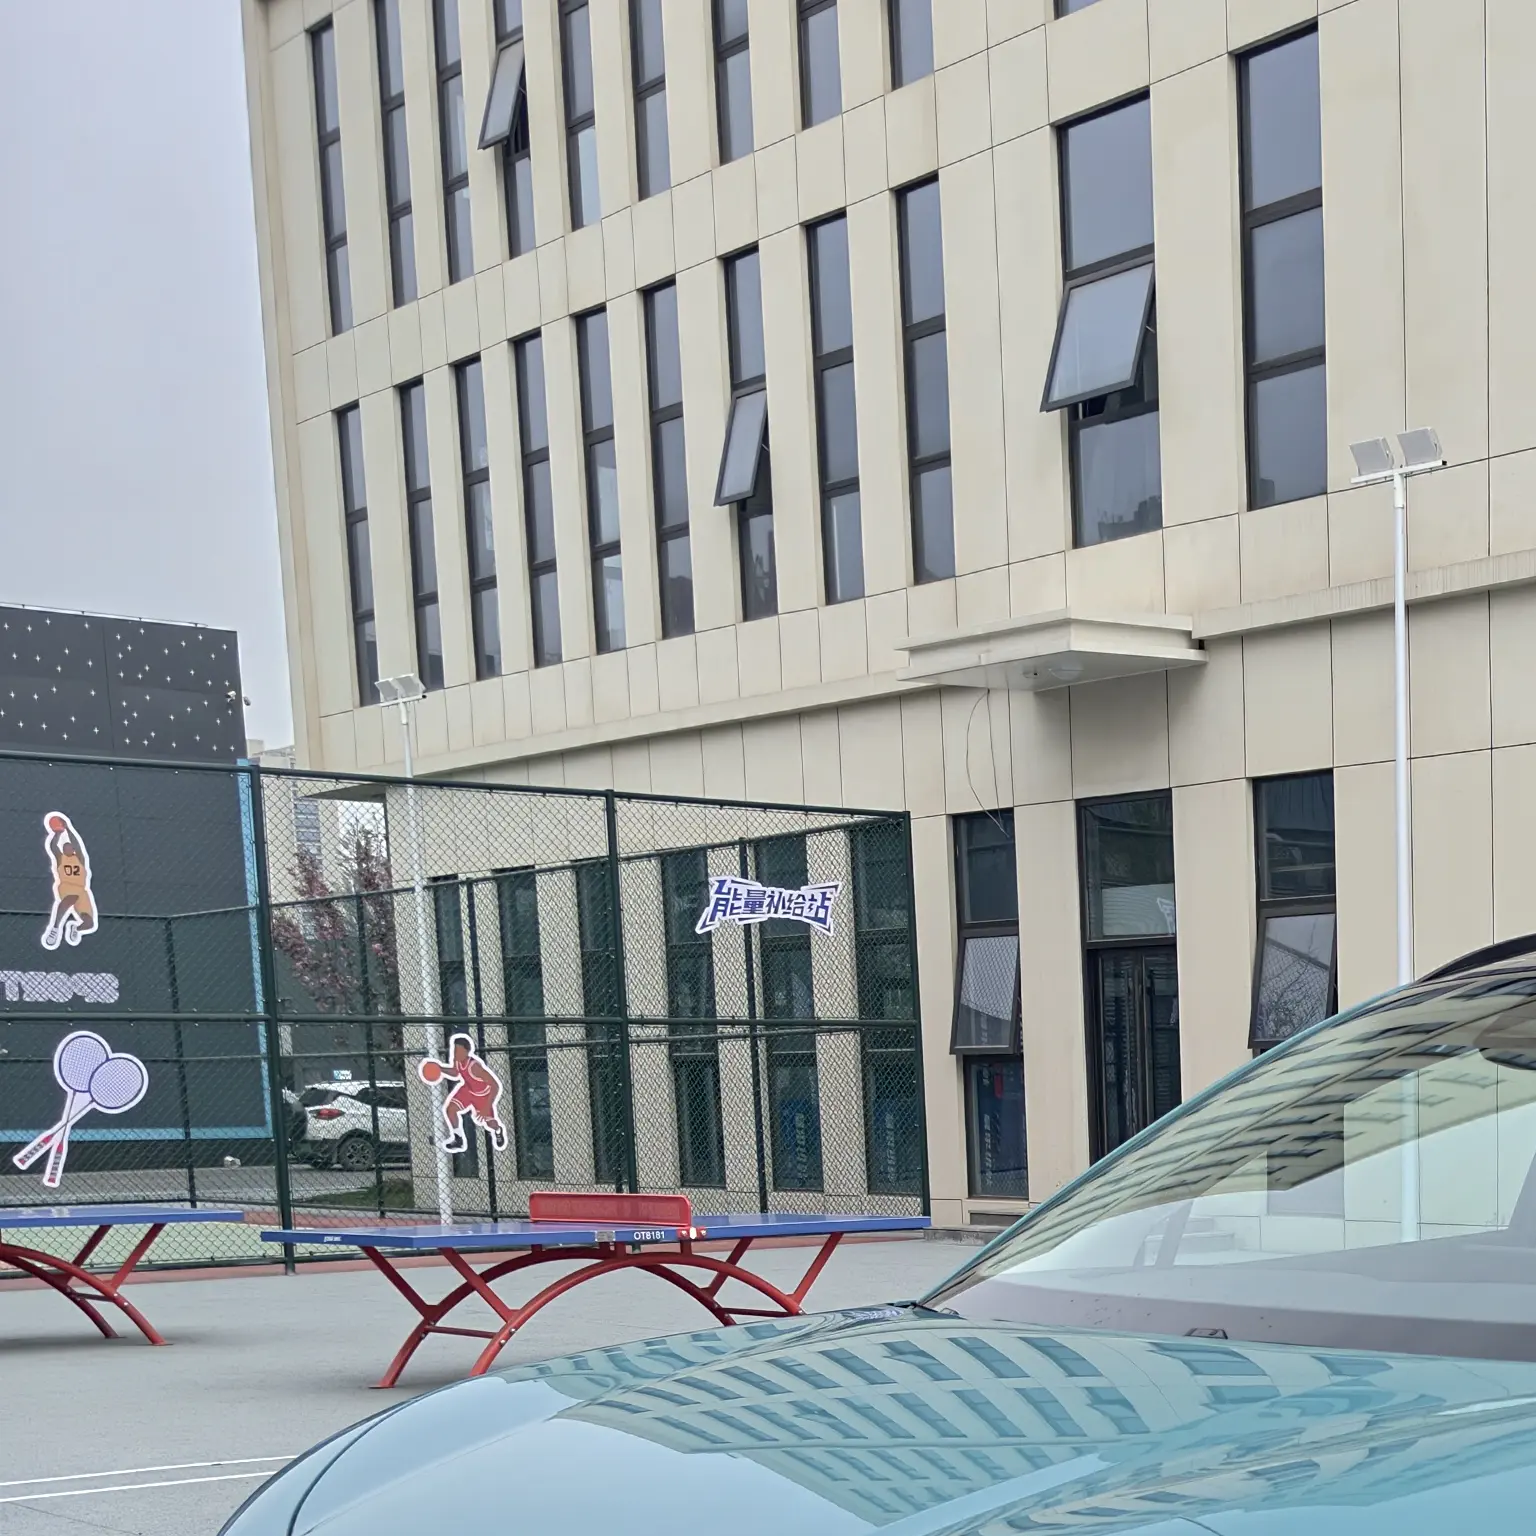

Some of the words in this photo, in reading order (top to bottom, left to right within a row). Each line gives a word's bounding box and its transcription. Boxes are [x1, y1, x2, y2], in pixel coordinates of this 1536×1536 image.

[708, 879, 832, 926] 能量补给站
